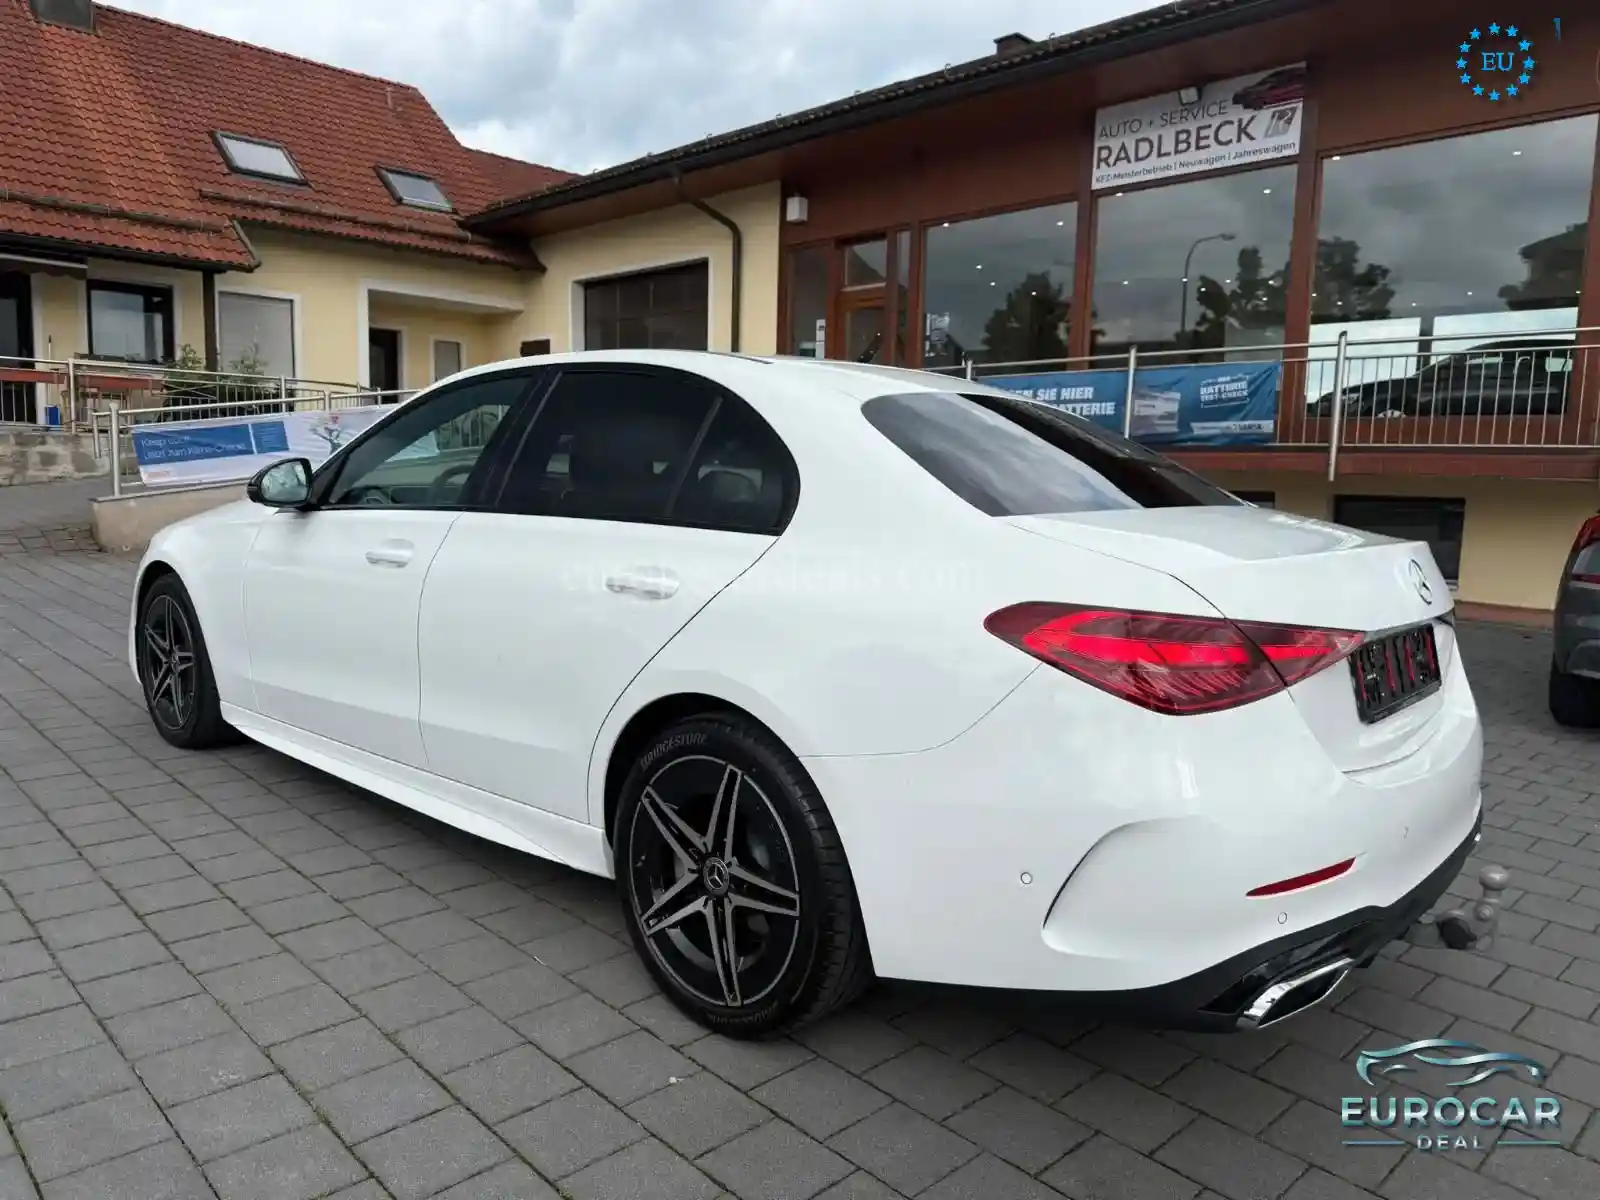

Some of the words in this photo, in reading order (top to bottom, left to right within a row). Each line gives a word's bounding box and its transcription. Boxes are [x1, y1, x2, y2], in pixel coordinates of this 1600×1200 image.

[1099, 118, 1143, 138] AUTO
[1159, 99, 1228, 127] SERVICE
[1095, 115, 1257, 169] RADLBECK
[1178, 154, 1227, 170] Neuwagen
[1232, 142, 1297, 159] Jahreswagen
[1035, 388, 1057, 401] SIE
[1060, 387, 1095, 400] HIER
[1053, 402, 1117, 416] ATTERIE
